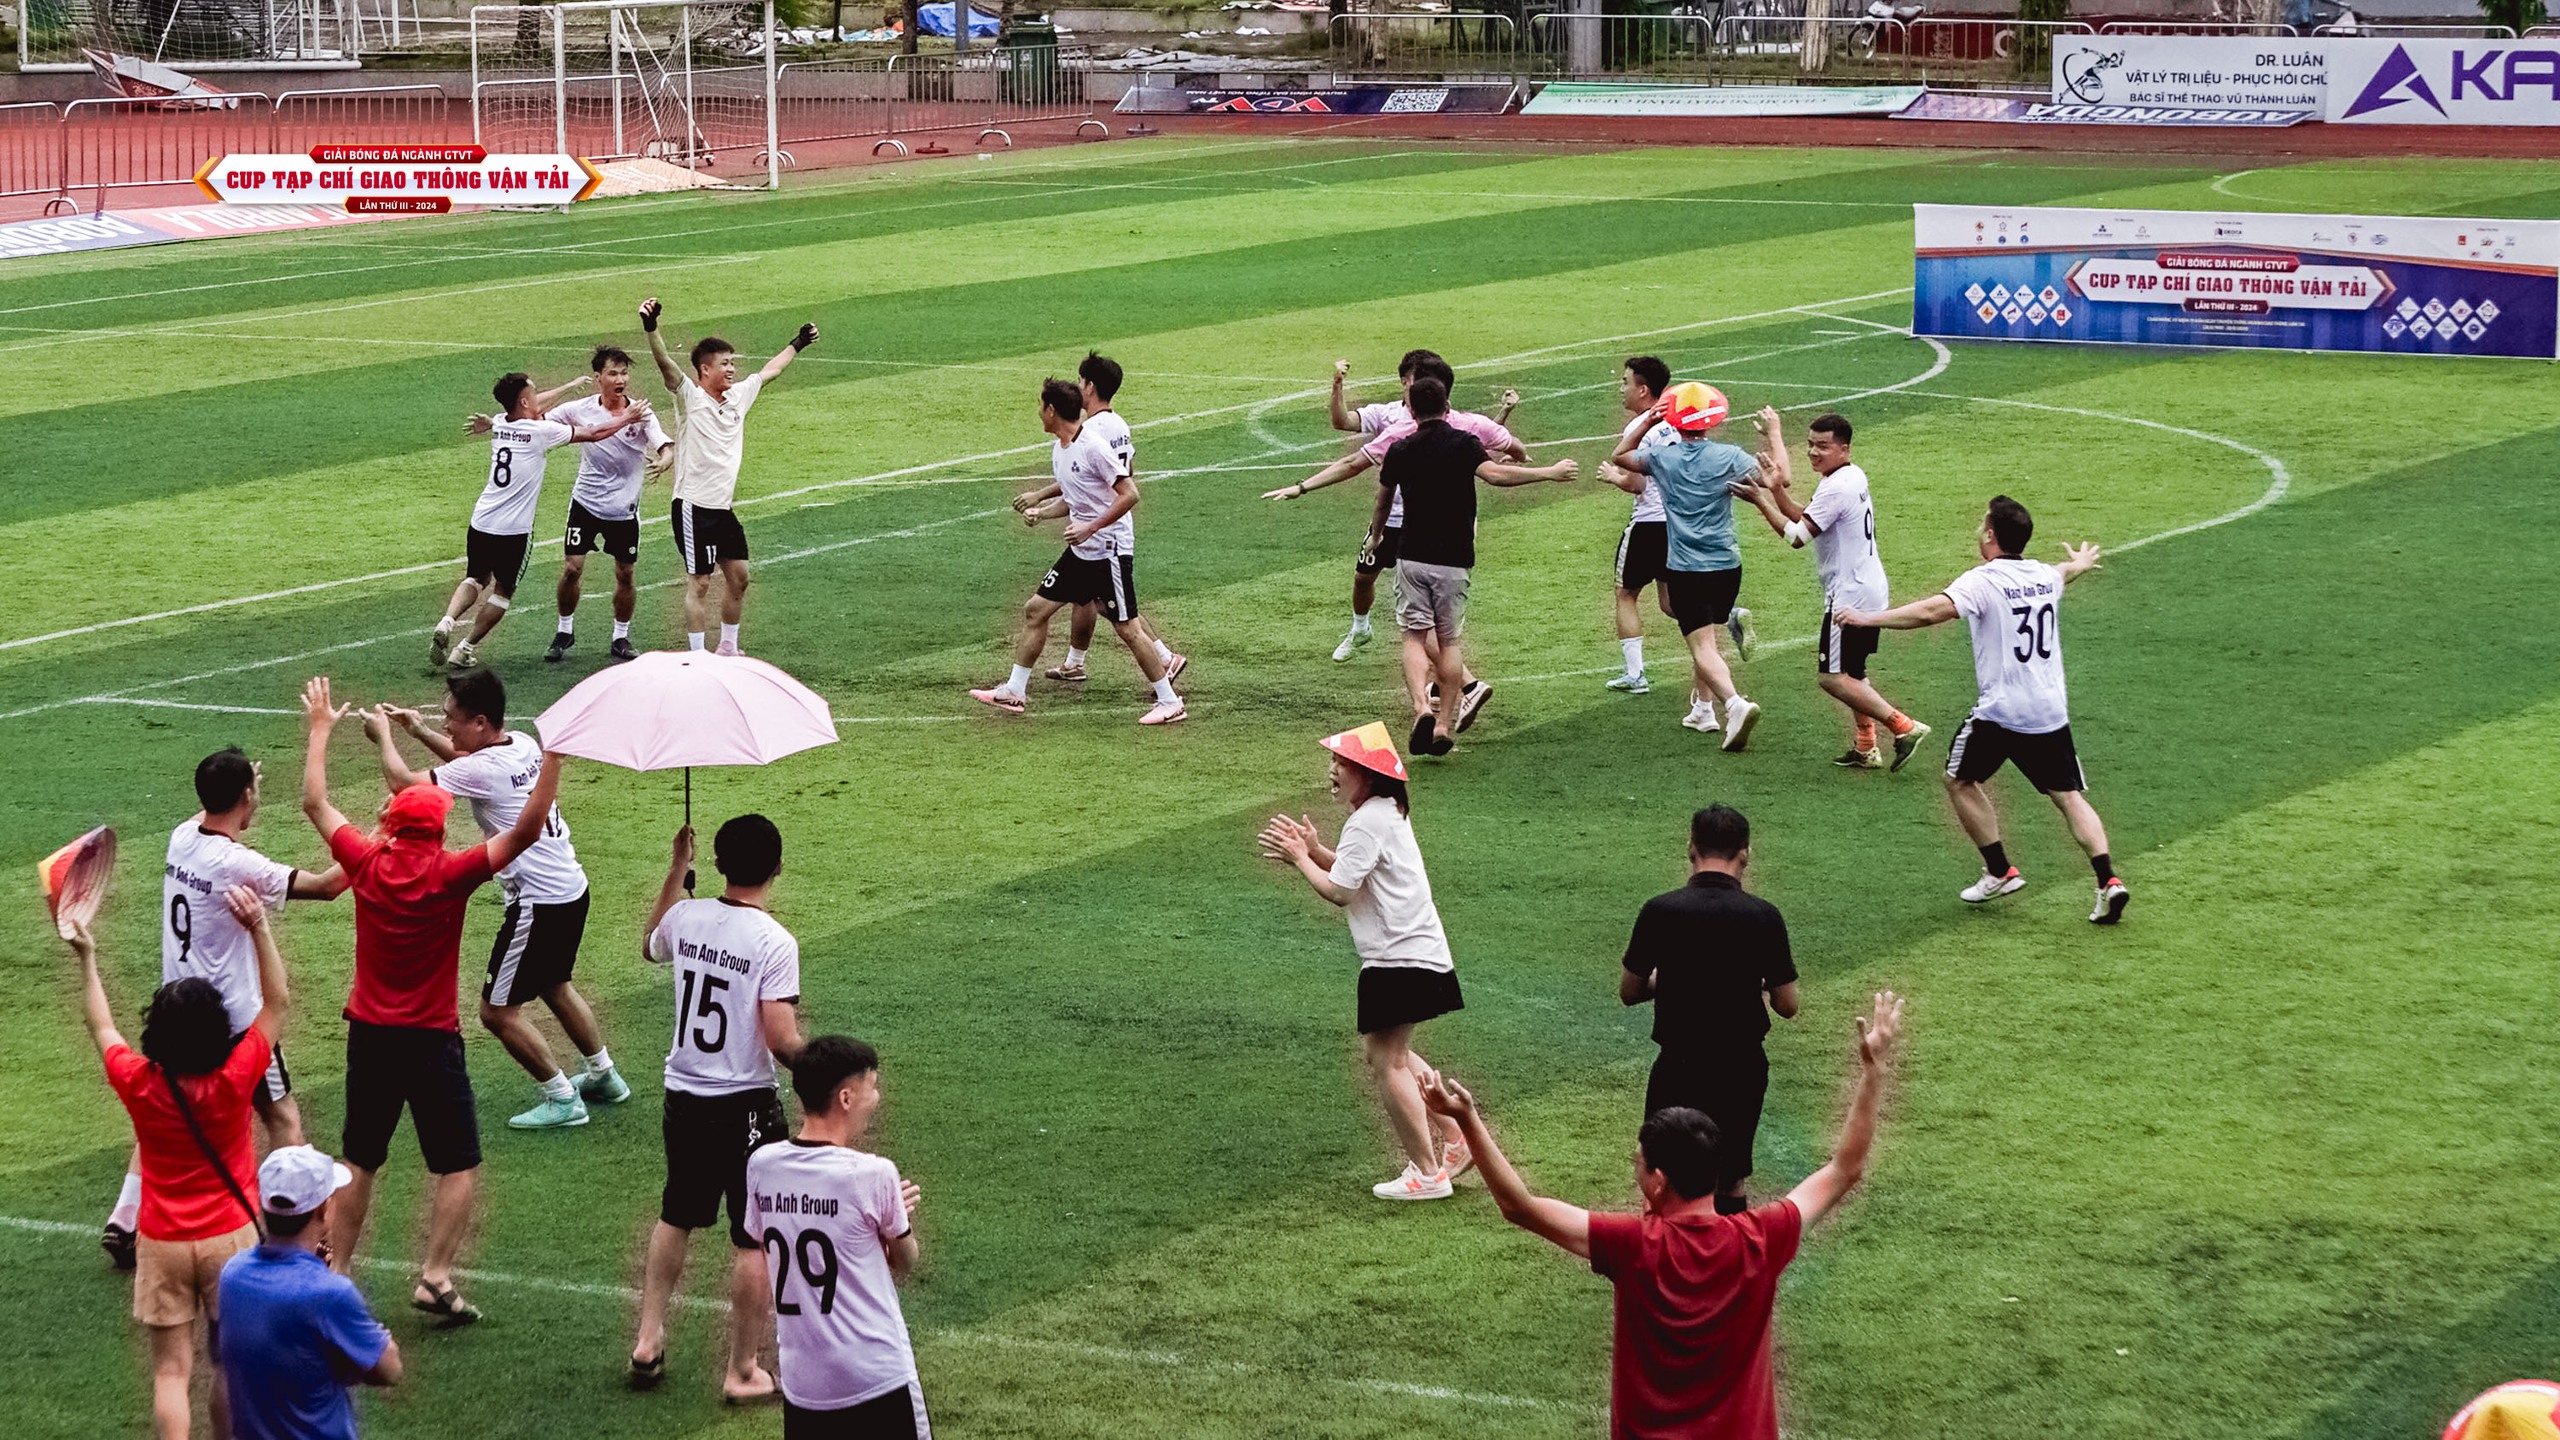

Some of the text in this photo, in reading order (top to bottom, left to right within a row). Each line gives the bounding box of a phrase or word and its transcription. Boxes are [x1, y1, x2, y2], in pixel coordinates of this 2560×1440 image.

[2255, 51, 2324, 67] DR. LUÂN
[2126, 69, 2150, 86] VẬT
[2152, 70, 2167, 84] LÝ
[2171, 72, 2190, 87] TRỊ
[2193, 70, 2222, 87] LIỆU
[2233, 73, 2271, 88] PHỤC
[2129, 92, 2152, 103] BÁC
[2227, 92, 2242, 104] VŨ
[2245, 93, 2284, 105] THÀNH
[2286, 93, 2316, 105] LUÂN
[2166, 256, 2289, 270] GIẢI BÓNG ĐÁ NGÀNH GTVT
[2089, 272, 2367, 299] CUP TẠP CHÍ GIAO THÔNG VẬN TẢI
[2210, 301, 2226, 310] THỨ
[2240, 303, 2258, 311] 2024
[494, 446, 512, 488] 8
[567, 527, 581, 546] 13
[705, 545, 717, 565] 11
[2004, 587, 2021, 600] Nam
[2012, 603, 2055, 663] 30
[511, 772, 528, 789] Nam
[189, 872, 212, 896] Group
[171, 893, 191, 963] 9
[678, 938, 751, 976] Nam Anh Group
[678, 969, 730, 1054] 15
[775, 1192, 798, 1214] Anh
[801, 1193, 839, 1218] Group
[763, 1226, 838, 1316] 29
